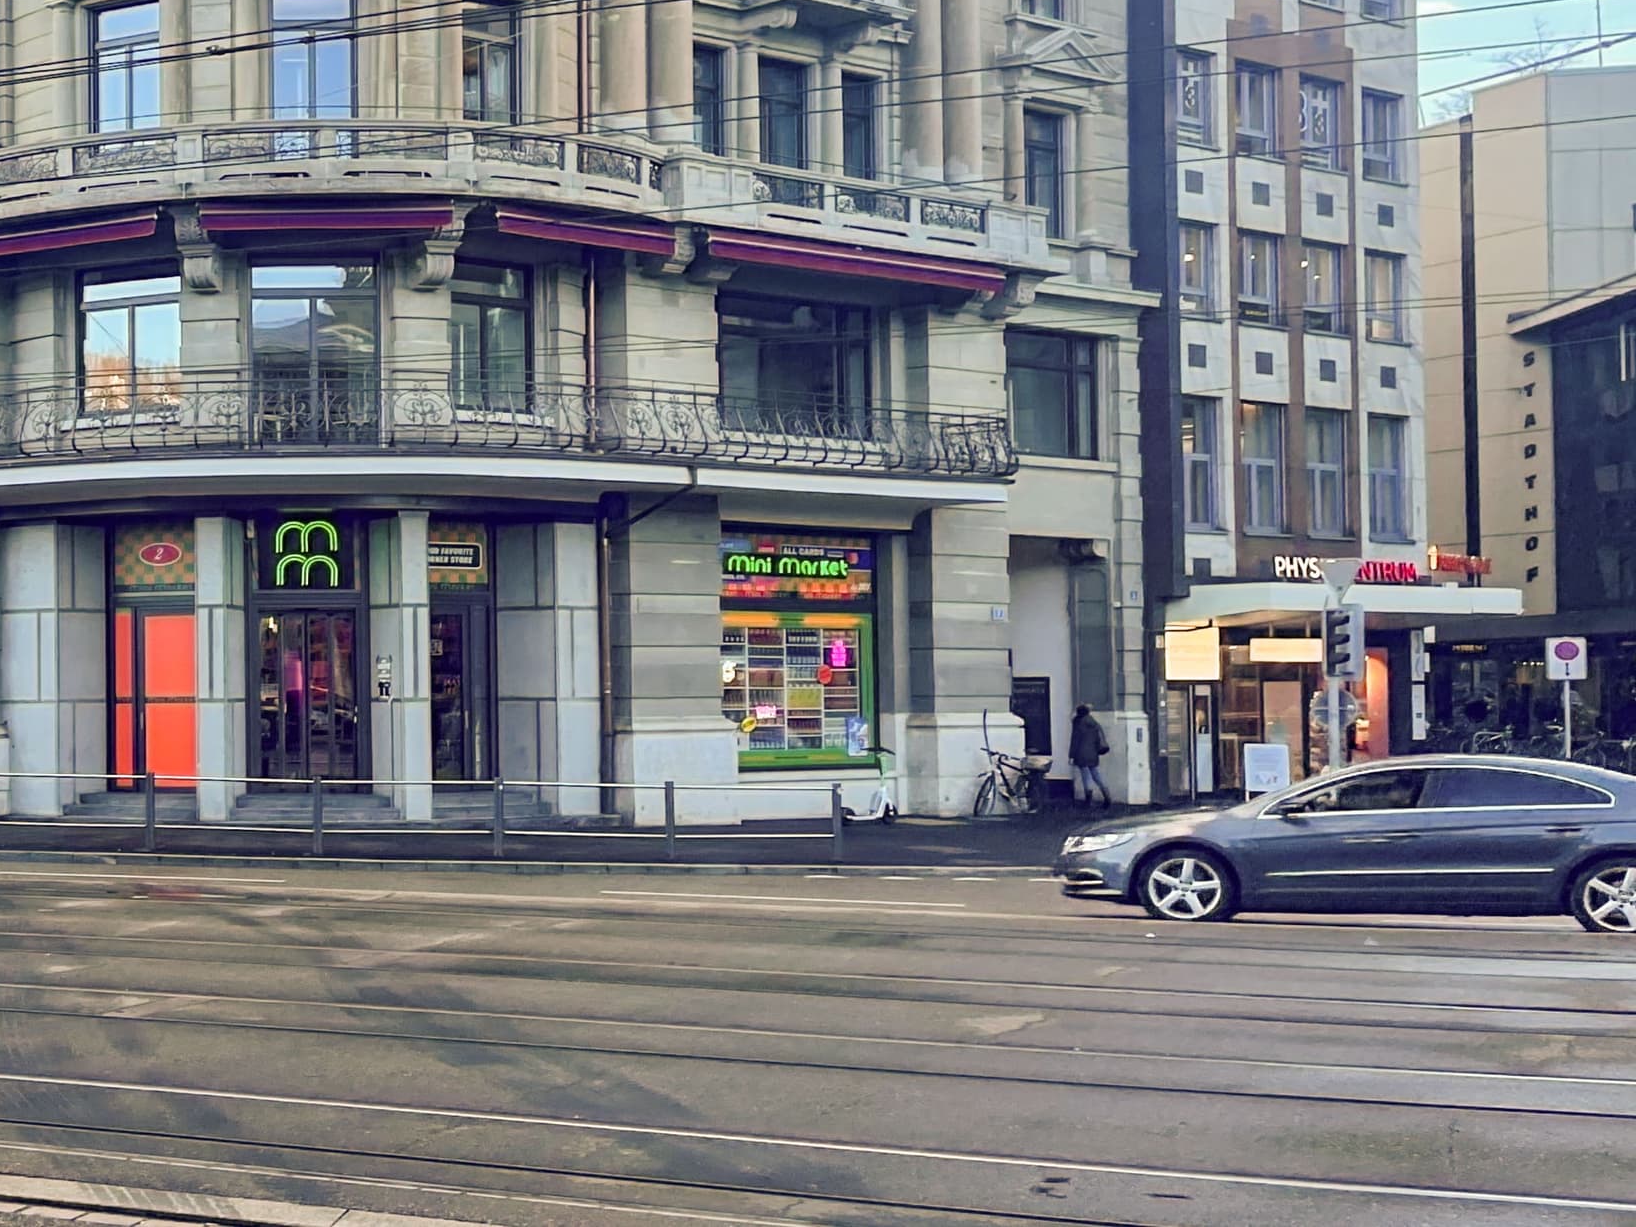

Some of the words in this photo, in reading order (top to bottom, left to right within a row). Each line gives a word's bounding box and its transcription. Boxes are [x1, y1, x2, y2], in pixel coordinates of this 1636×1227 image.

[1522, 351, 1539, 583] STADTHOF
[154, 547, 164, 561] 2
[727, 554, 772, 573] Mini
[778, 556, 849, 576] Market
